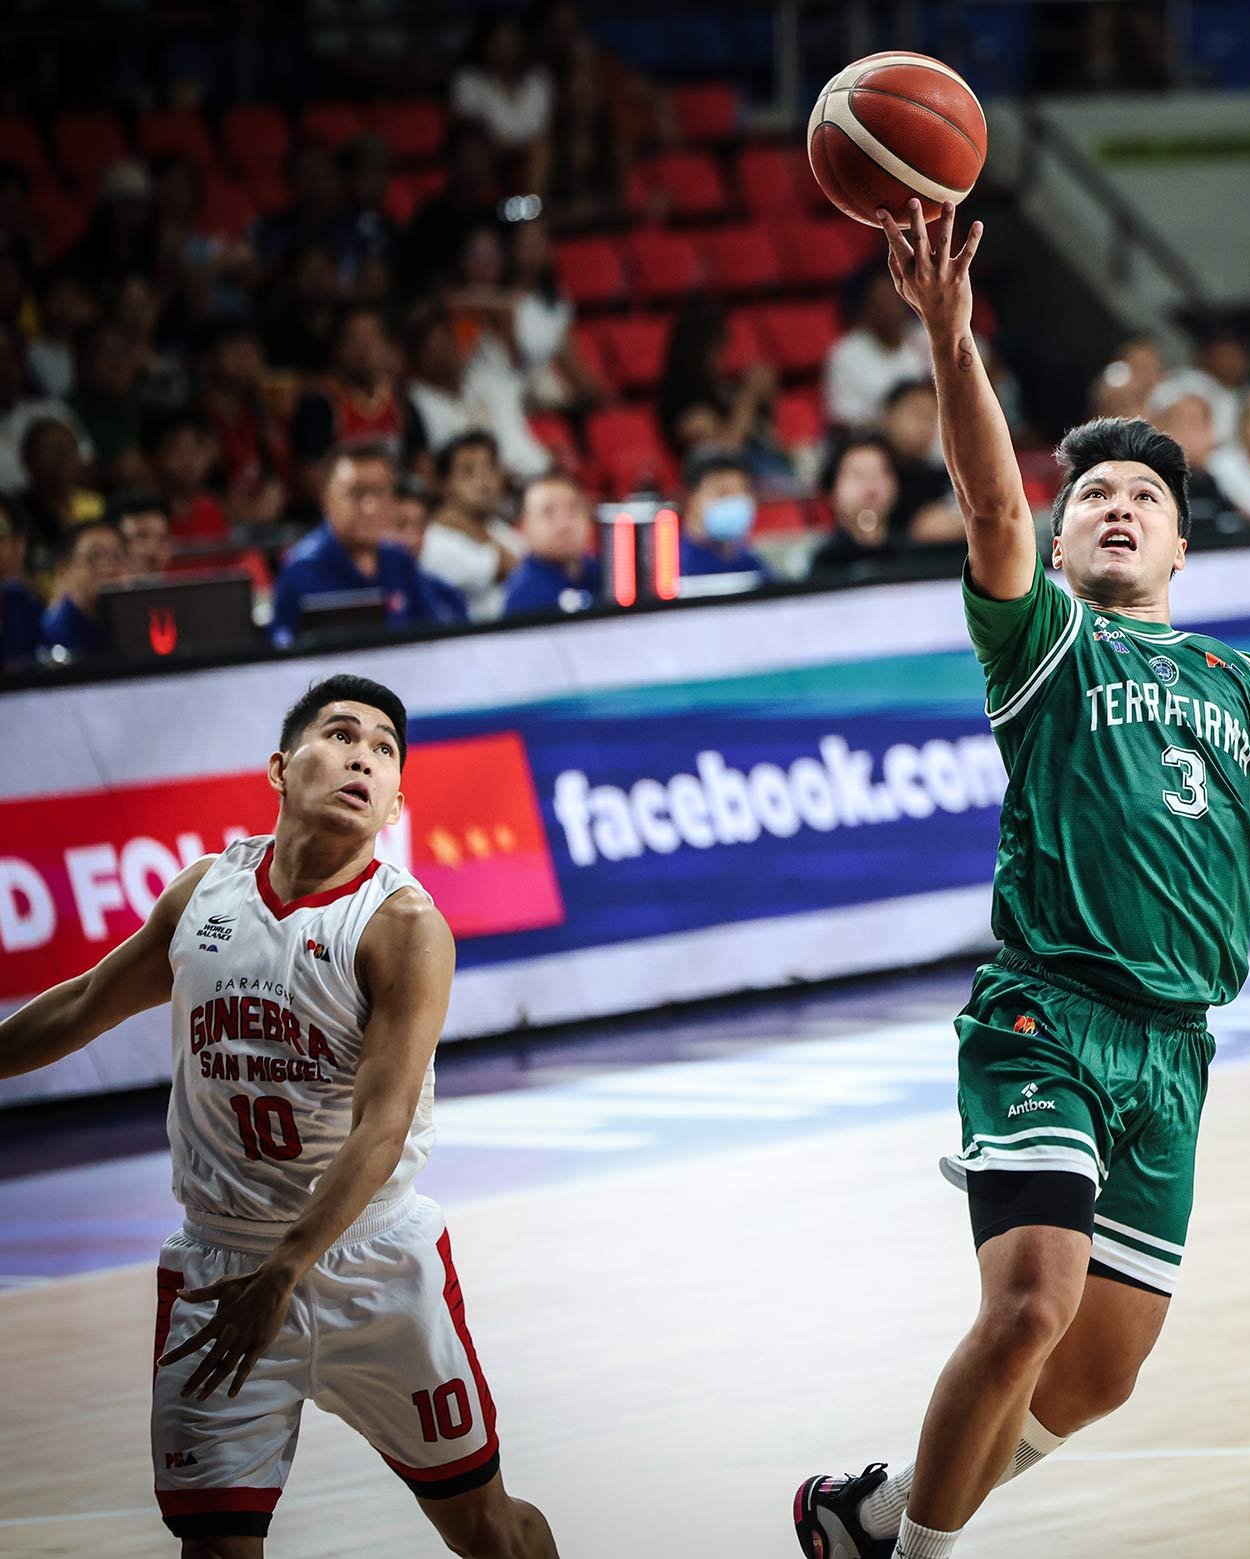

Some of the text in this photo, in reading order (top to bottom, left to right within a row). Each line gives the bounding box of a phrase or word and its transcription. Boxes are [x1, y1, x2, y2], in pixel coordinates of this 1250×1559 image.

[1161, 743, 1210, 820] 3
[196, 930, 232, 942] BALANCE
[203, 924, 233, 935] WORLD
[189, 995, 339, 1070] GINEBRA
[200, 1051, 333, 1084] SAN MIGUEL
[229, 1093, 303, 1161] 10
[1007, 1098, 1056, 1118] Antbox
[411, 1377, 474, 1443] 10
